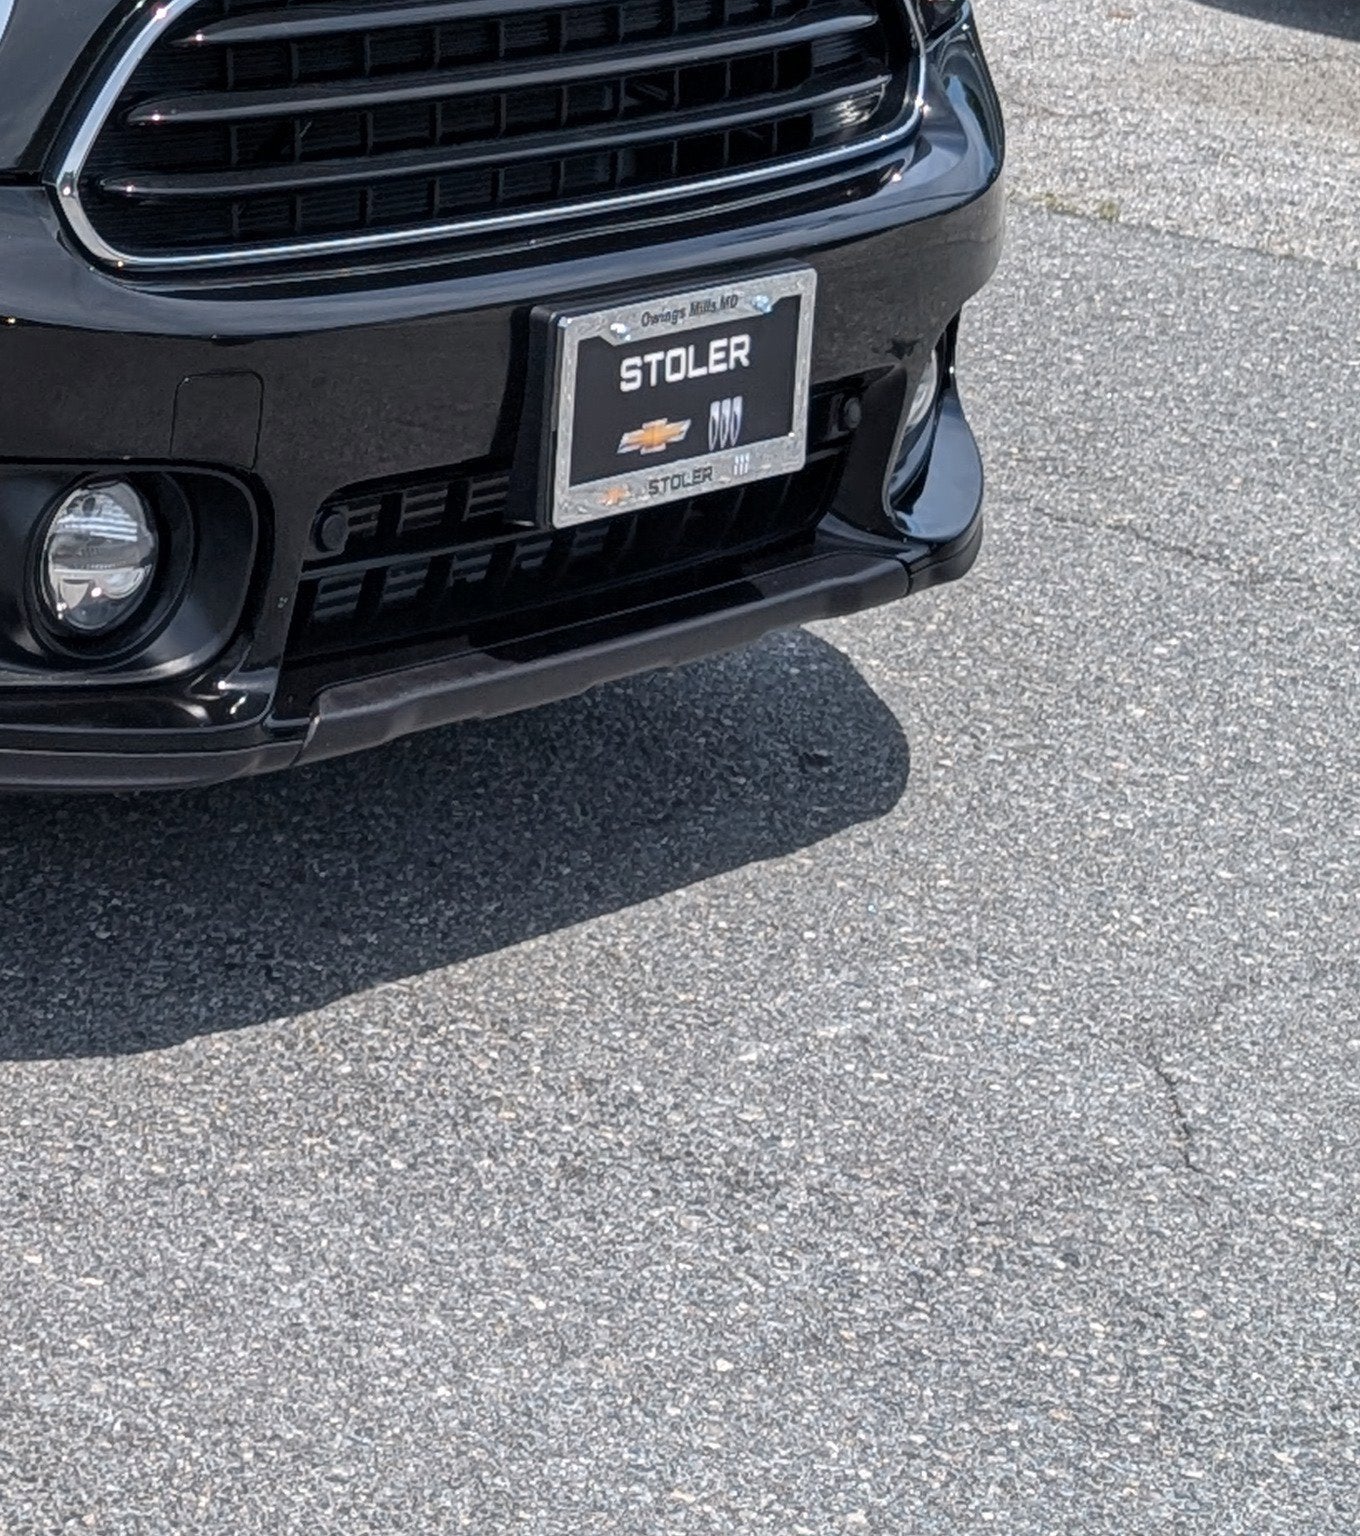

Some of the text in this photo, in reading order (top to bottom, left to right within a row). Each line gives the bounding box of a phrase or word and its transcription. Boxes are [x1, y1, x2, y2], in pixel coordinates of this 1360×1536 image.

[641, 307, 686, 327] Owings
[620, 334, 750, 392] STOLER
[648, 465, 713, 496] STOLER
